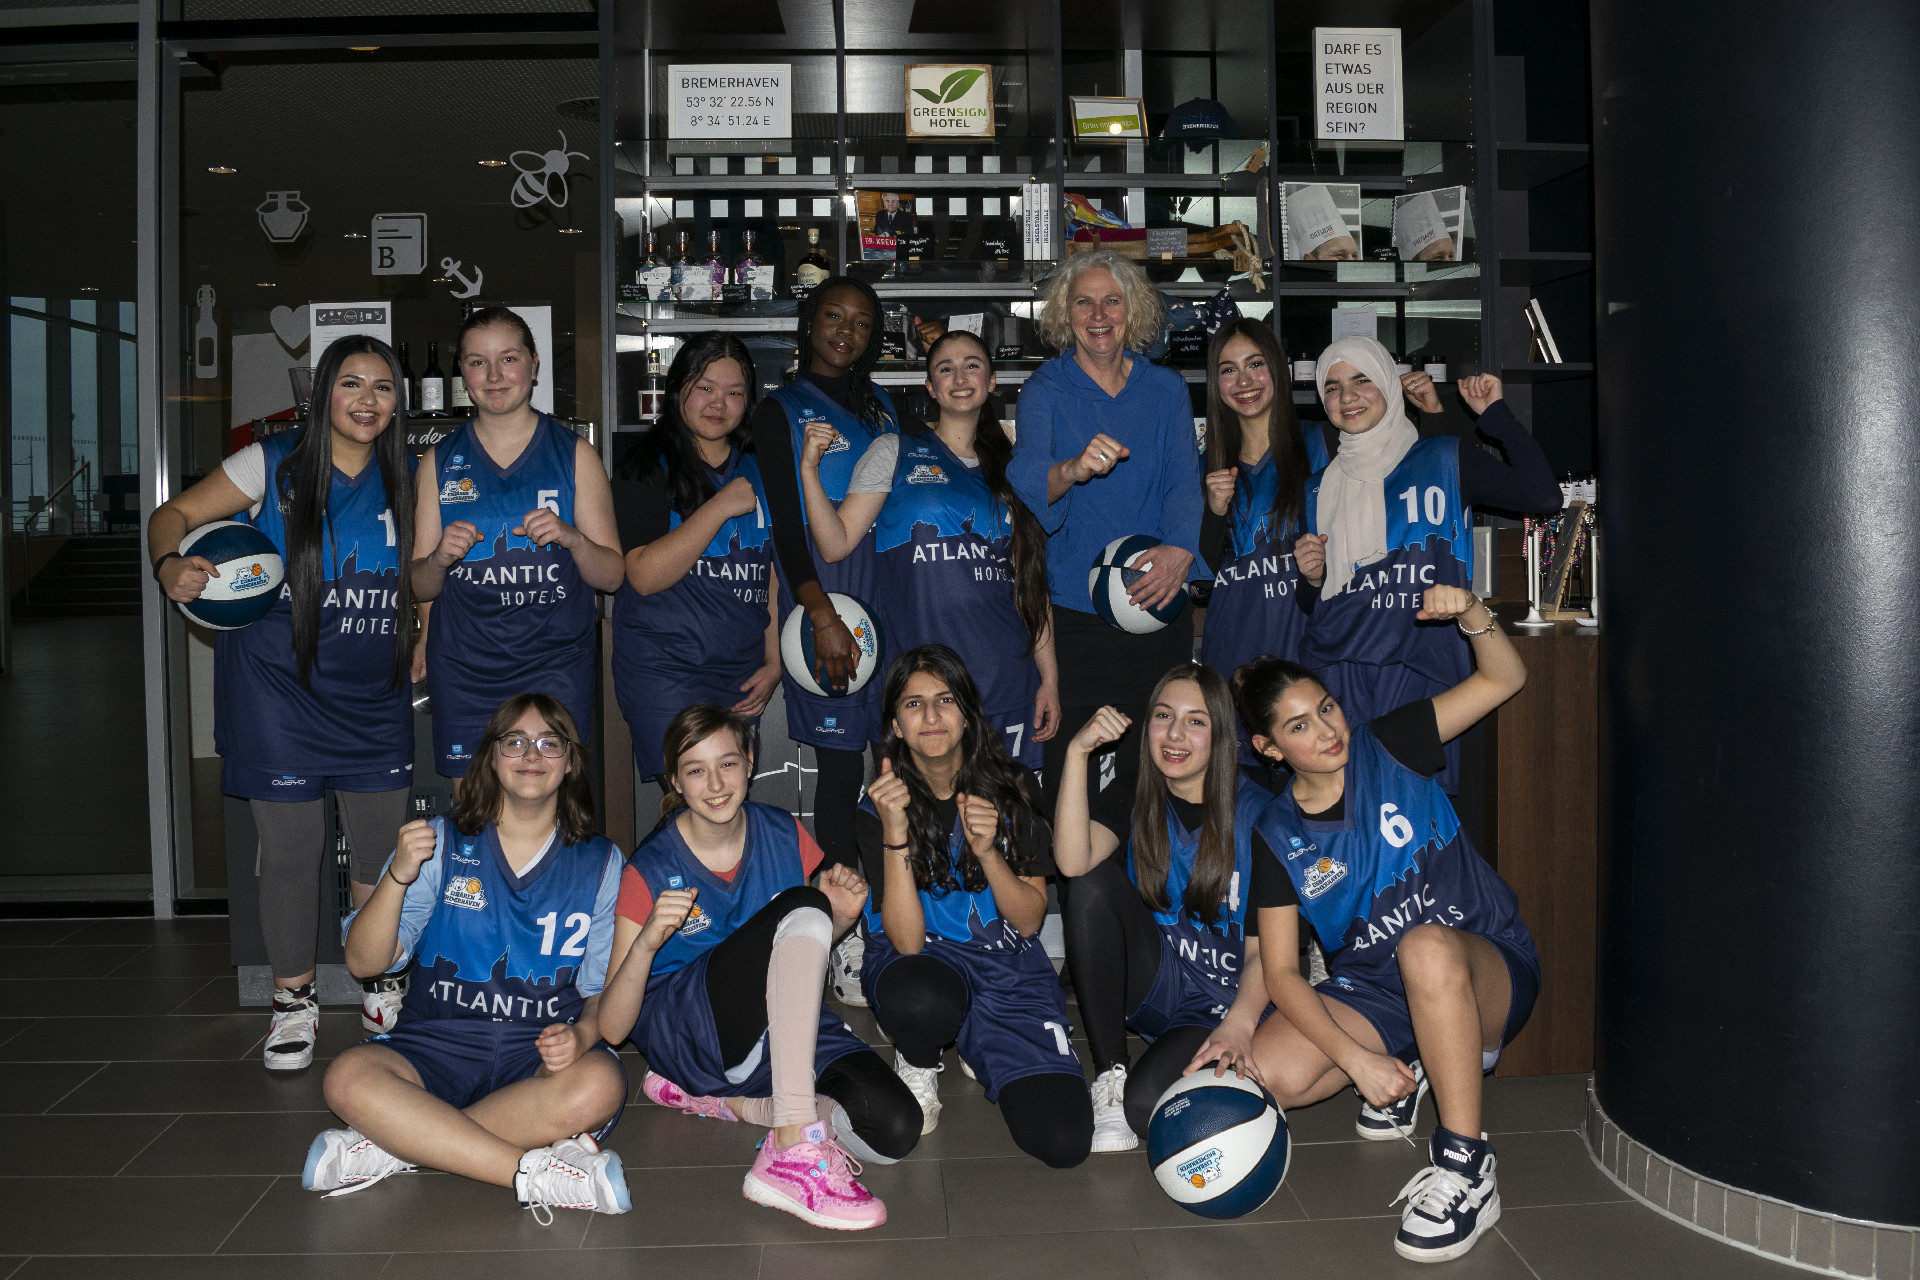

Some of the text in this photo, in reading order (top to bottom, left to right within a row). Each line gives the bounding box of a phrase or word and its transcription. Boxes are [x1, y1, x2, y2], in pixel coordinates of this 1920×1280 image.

[1324, 43, 1382, 55] DARF ES
[1325, 63, 1371, 74] ETWAS
[682, 77, 779, 88] BREMERHAVEN
[1325, 82, 1384, 94] AUS DER
[730, 96, 761, 107] 22.56
[765, 96, 774, 106] N
[1326, 102, 1377, 113] REGION
[913, 107, 987, 117] GREENSIGN
[728, 115, 759, 126] 51.24
[763, 116, 770, 126] E
[929, 118, 970, 127] HOTEL
[1326, 121, 1366, 133] SEIN?
[537, 489, 560, 517] 5
[1399, 485, 1446, 526] 10
[1213, 552, 1294, 588] ATLANT
[1345, 564, 1436, 593] LANTIC
[500, 585, 566, 606] HOTELS
[1264, 578, 1298, 599] HOT
[1372, 592, 1420, 609] HOTE
[1005, 722, 1025, 758] 7
[1380, 802, 1414, 848] 6
[536, 911, 592, 957] 12
[429, 980, 560, 1019] ATLANTIC
[1443, 1148, 1468, 1164] PUMA
